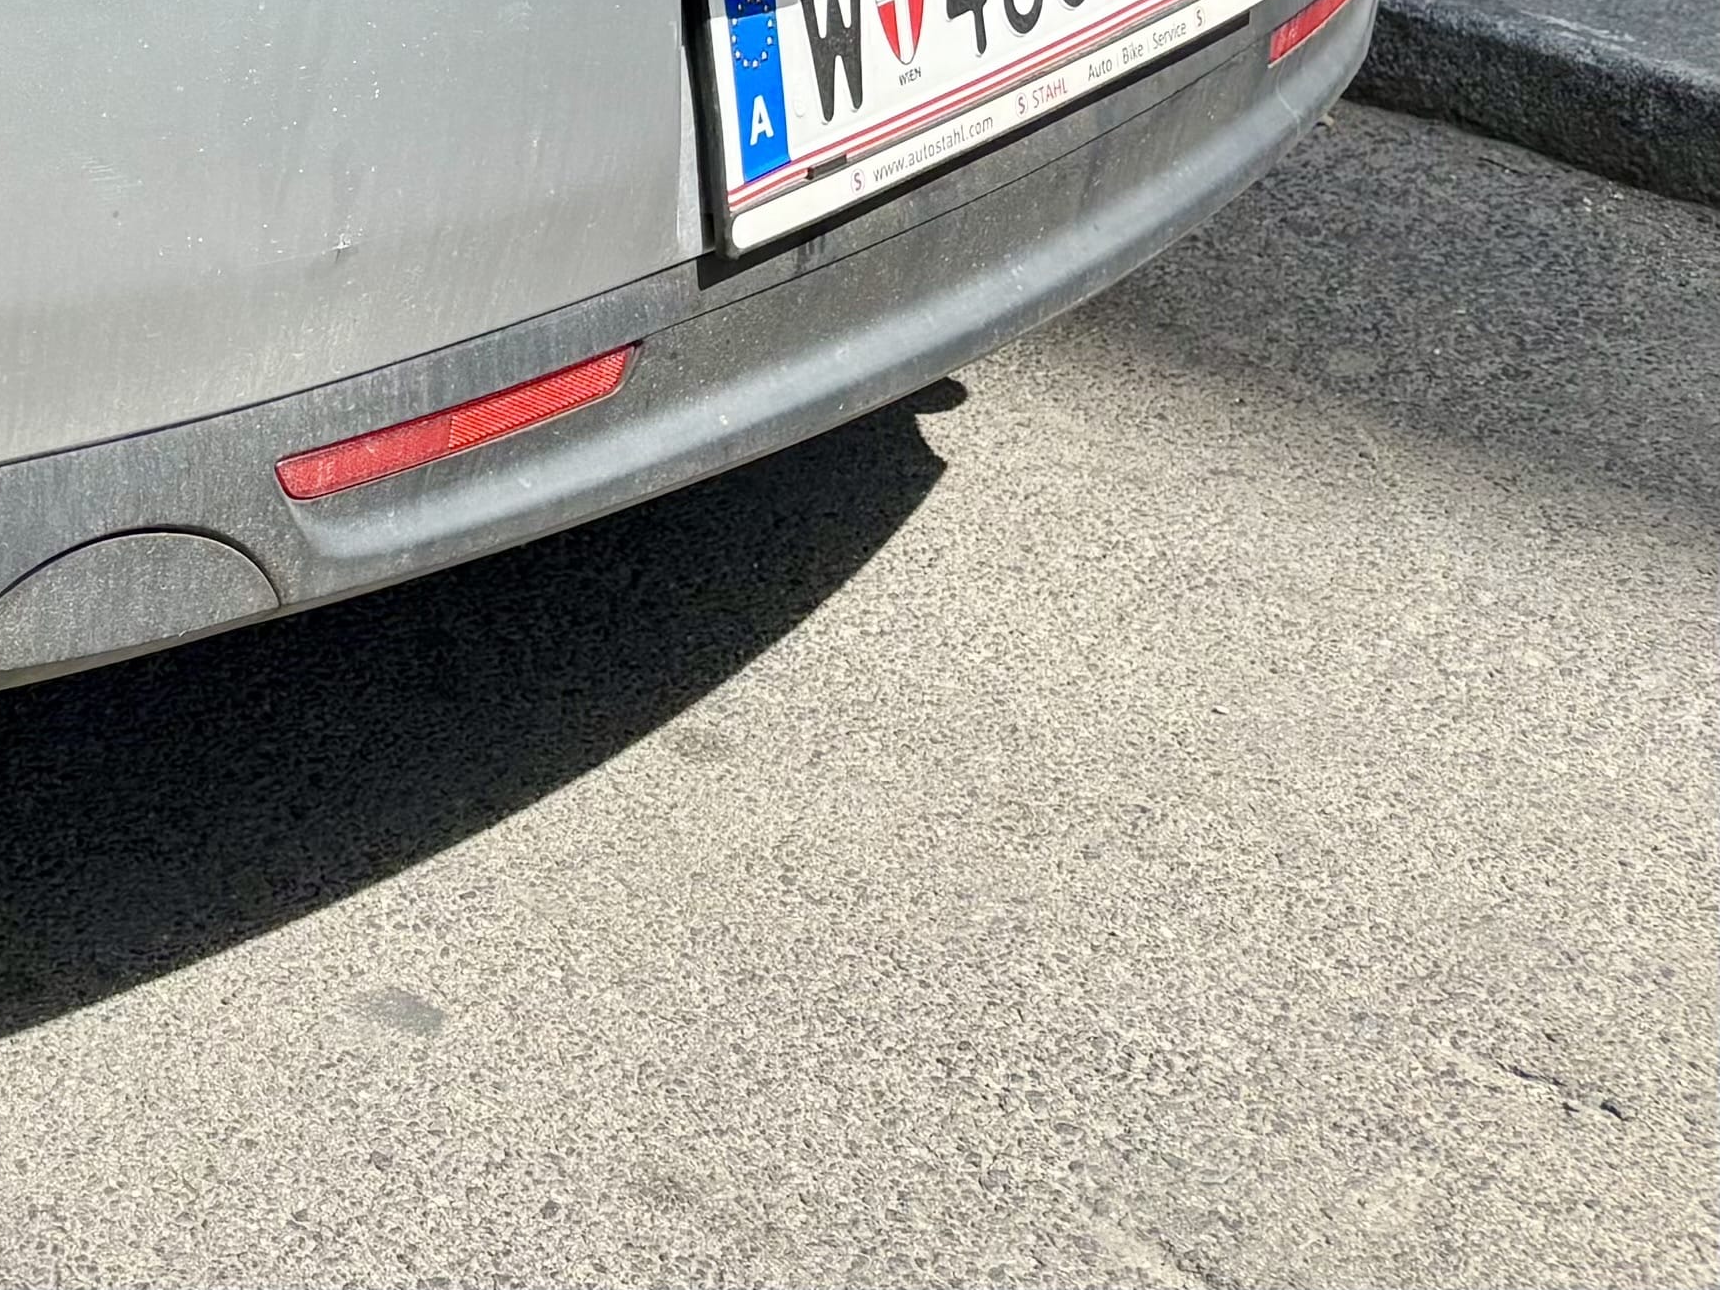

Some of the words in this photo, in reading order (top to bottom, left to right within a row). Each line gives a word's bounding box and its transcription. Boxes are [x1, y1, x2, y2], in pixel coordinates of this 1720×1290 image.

[899, 66, 922, 86] WIEN
[1032, 81, 1069, 109] STAHL
[1088, 58, 1113, 82] Auto
[1122, 42, 1144, 65] Bike
[1152, 22, 1187, 50] Service
[749, 94, 774, 147] A
[873, 115, 994, 183] www.autostahl.com
